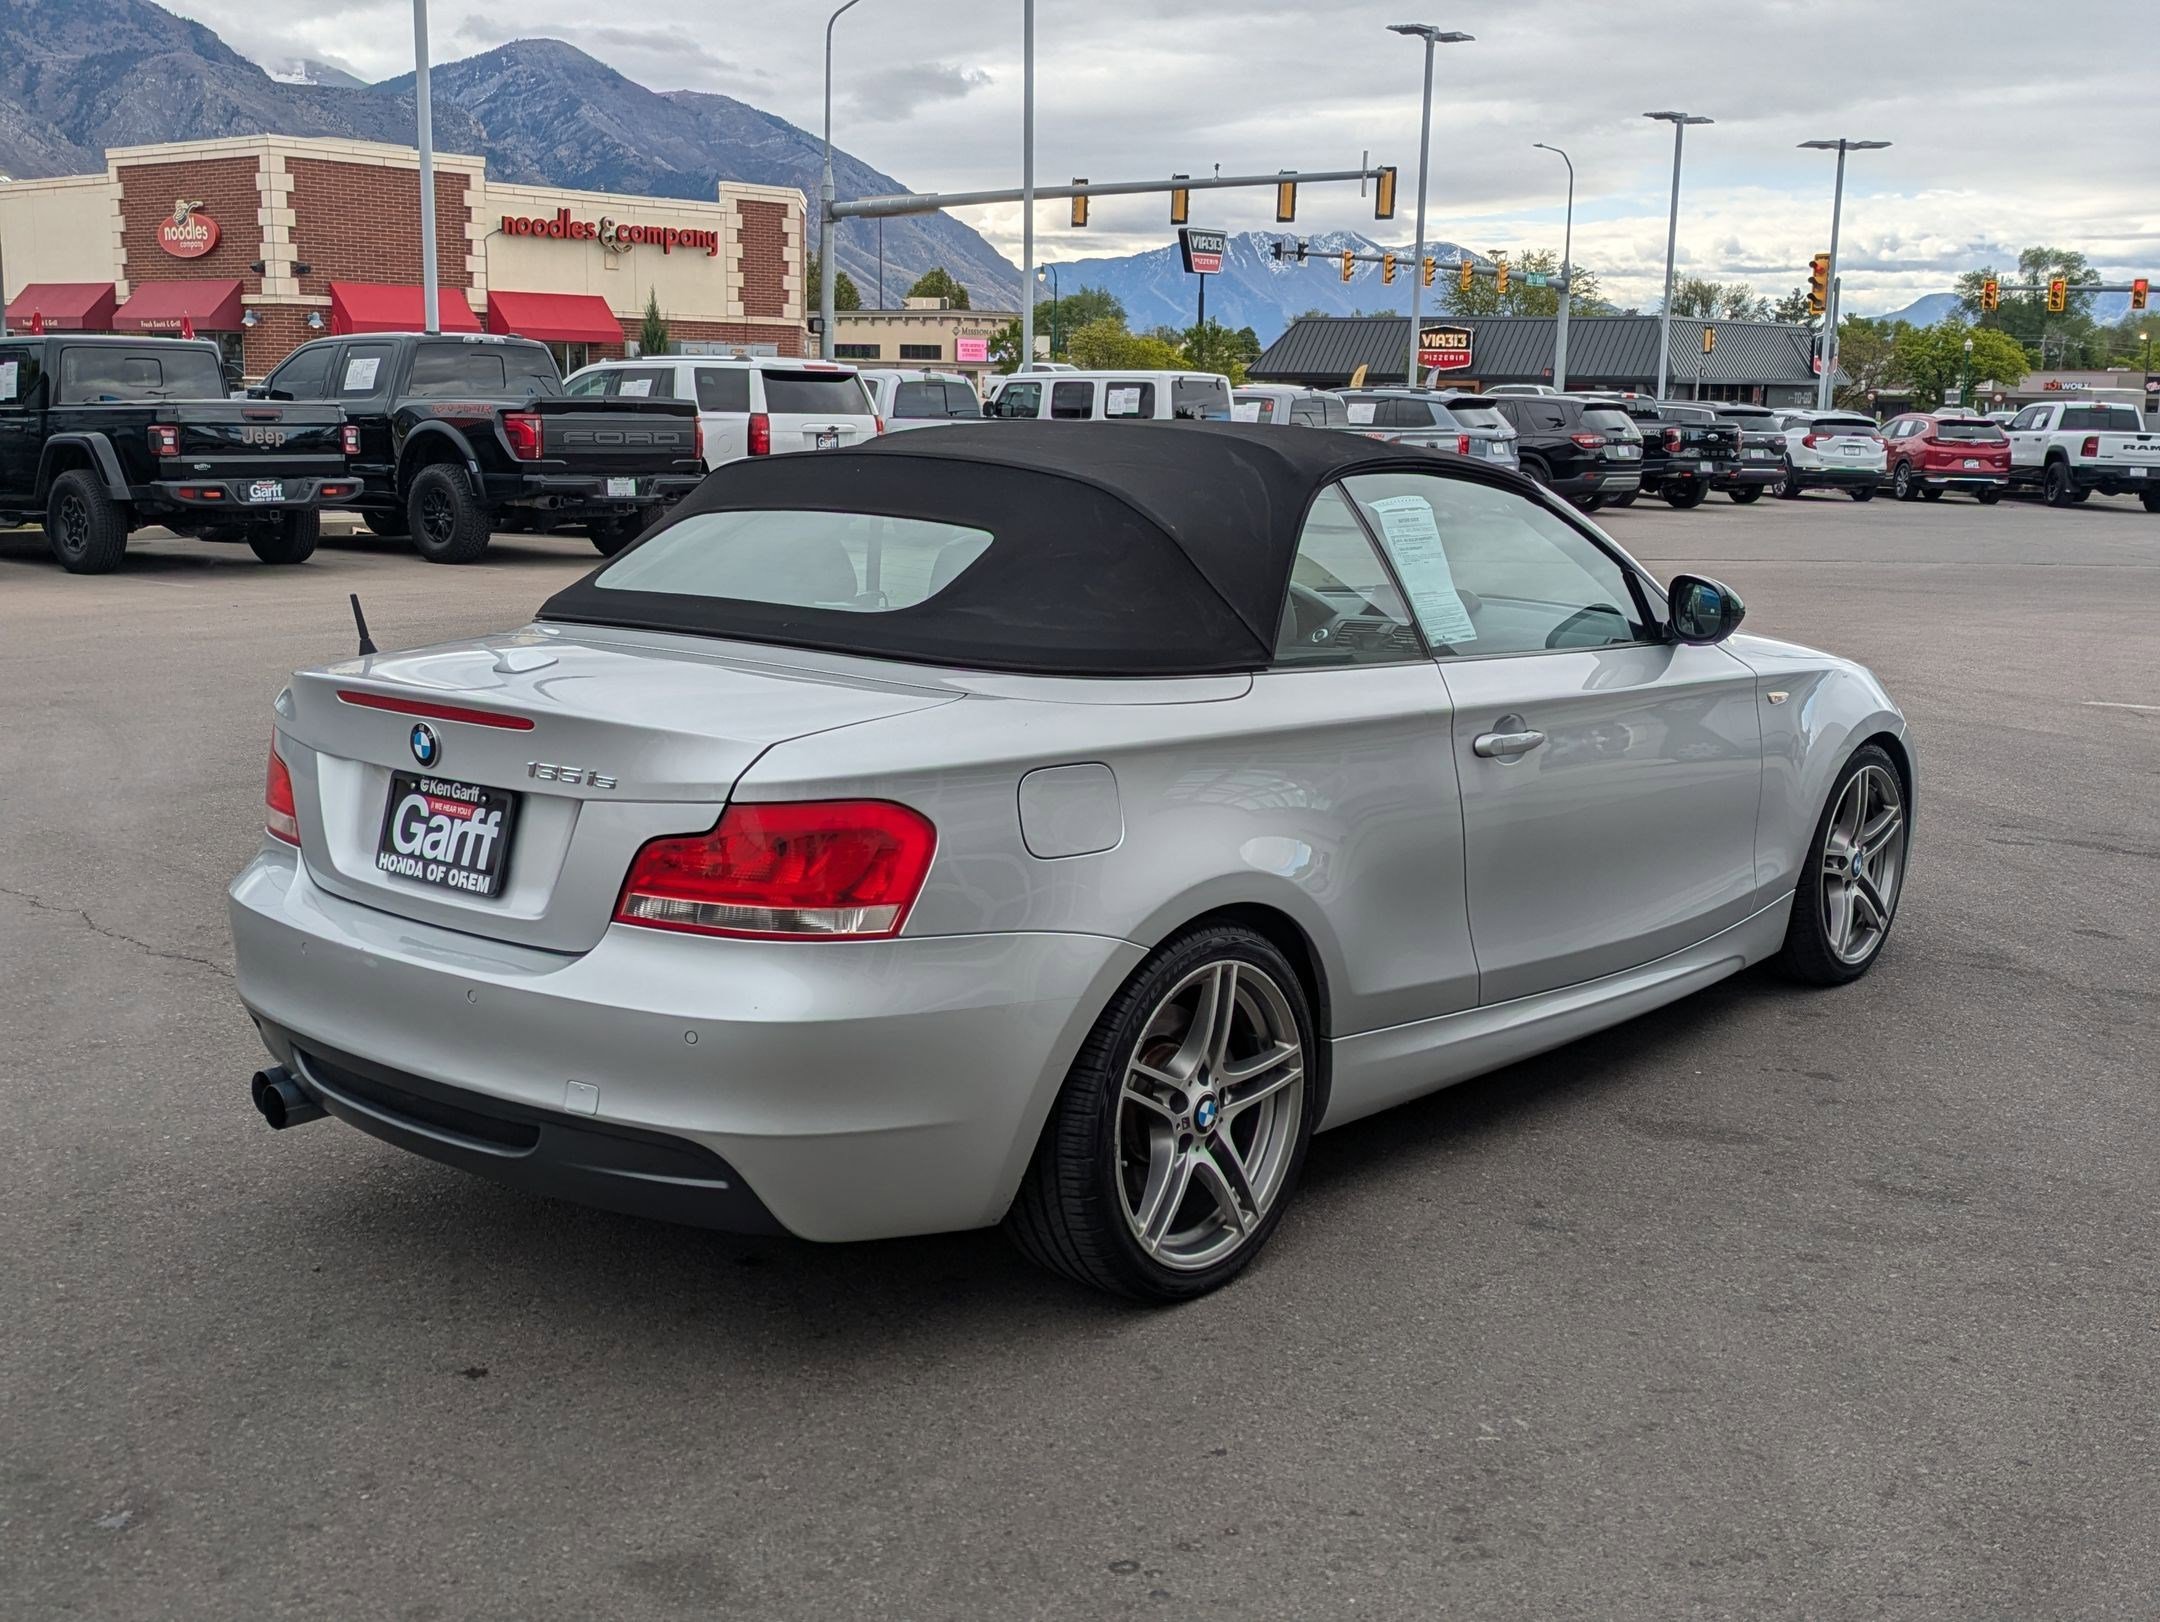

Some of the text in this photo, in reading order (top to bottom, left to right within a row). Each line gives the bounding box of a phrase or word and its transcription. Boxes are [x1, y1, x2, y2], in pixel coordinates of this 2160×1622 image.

[164, 216, 208, 240] noodles
[502, 208, 719, 257] noodles & company
[180, 241, 204, 251] company
[1421, 333, 1467, 347] VIA313
[242, 427, 285, 447] Jeep
[563, 431, 680, 444] FORD
[249, 484, 283, 498] Garff
[527, 761, 584, 784] 135
[429, 779, 480, 803] Ken Garff
[434, 802, 469, 816] WE HEAR YOU
[393, 793, 502, 871] Garff
[379, 852, 491, 894] HONDA OF OREM
